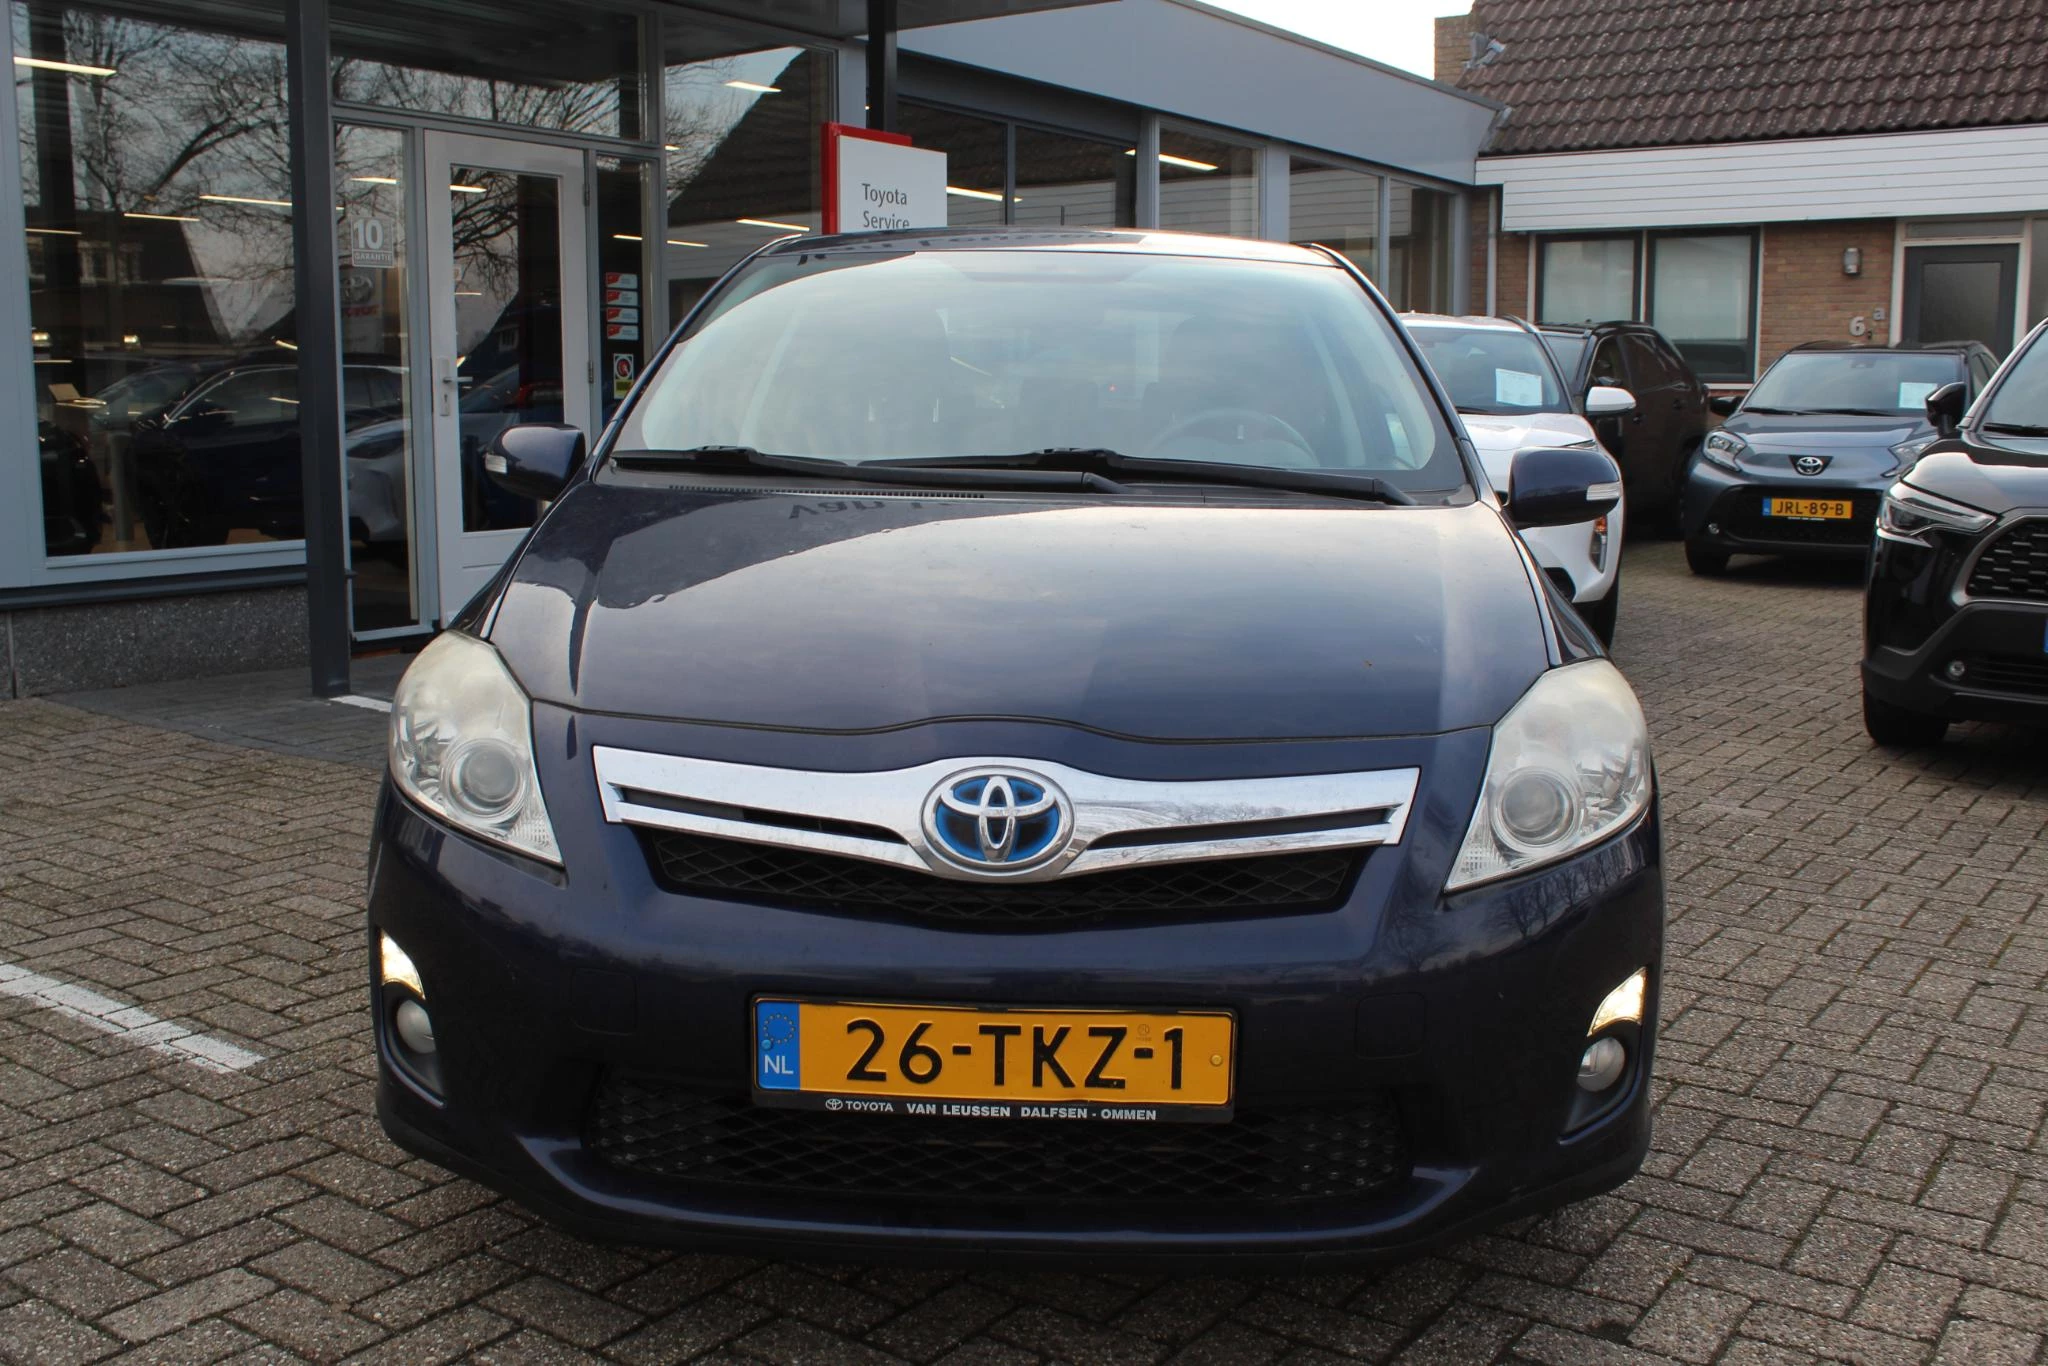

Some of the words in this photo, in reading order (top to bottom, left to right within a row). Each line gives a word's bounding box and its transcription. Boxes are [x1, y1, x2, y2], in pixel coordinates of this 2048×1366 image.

[861, 183, 907, 208] Toyota
[863, 210, 910, 229] Service
[353, 219, 383, 249] 10
[354, 251, 392, 262] GARANTIE
[1849, 316, 1865, 336] 6
[1776, 501, 1844, 516] JRL-89-B
[764, 1054, 794, 1075] NL
[846, 1018, 1184, 1090] 26-TKZ-1
[846, 1100, 894, 1113] TOYOTA
[906, 1103, 937, 1116] VAN
[942, 1104, 1011, 1118] LEUSSEN
[1020, 1106, 1088, 1119] DALFSEN
[1100, 1108, 1157, 1121] OMMEN
